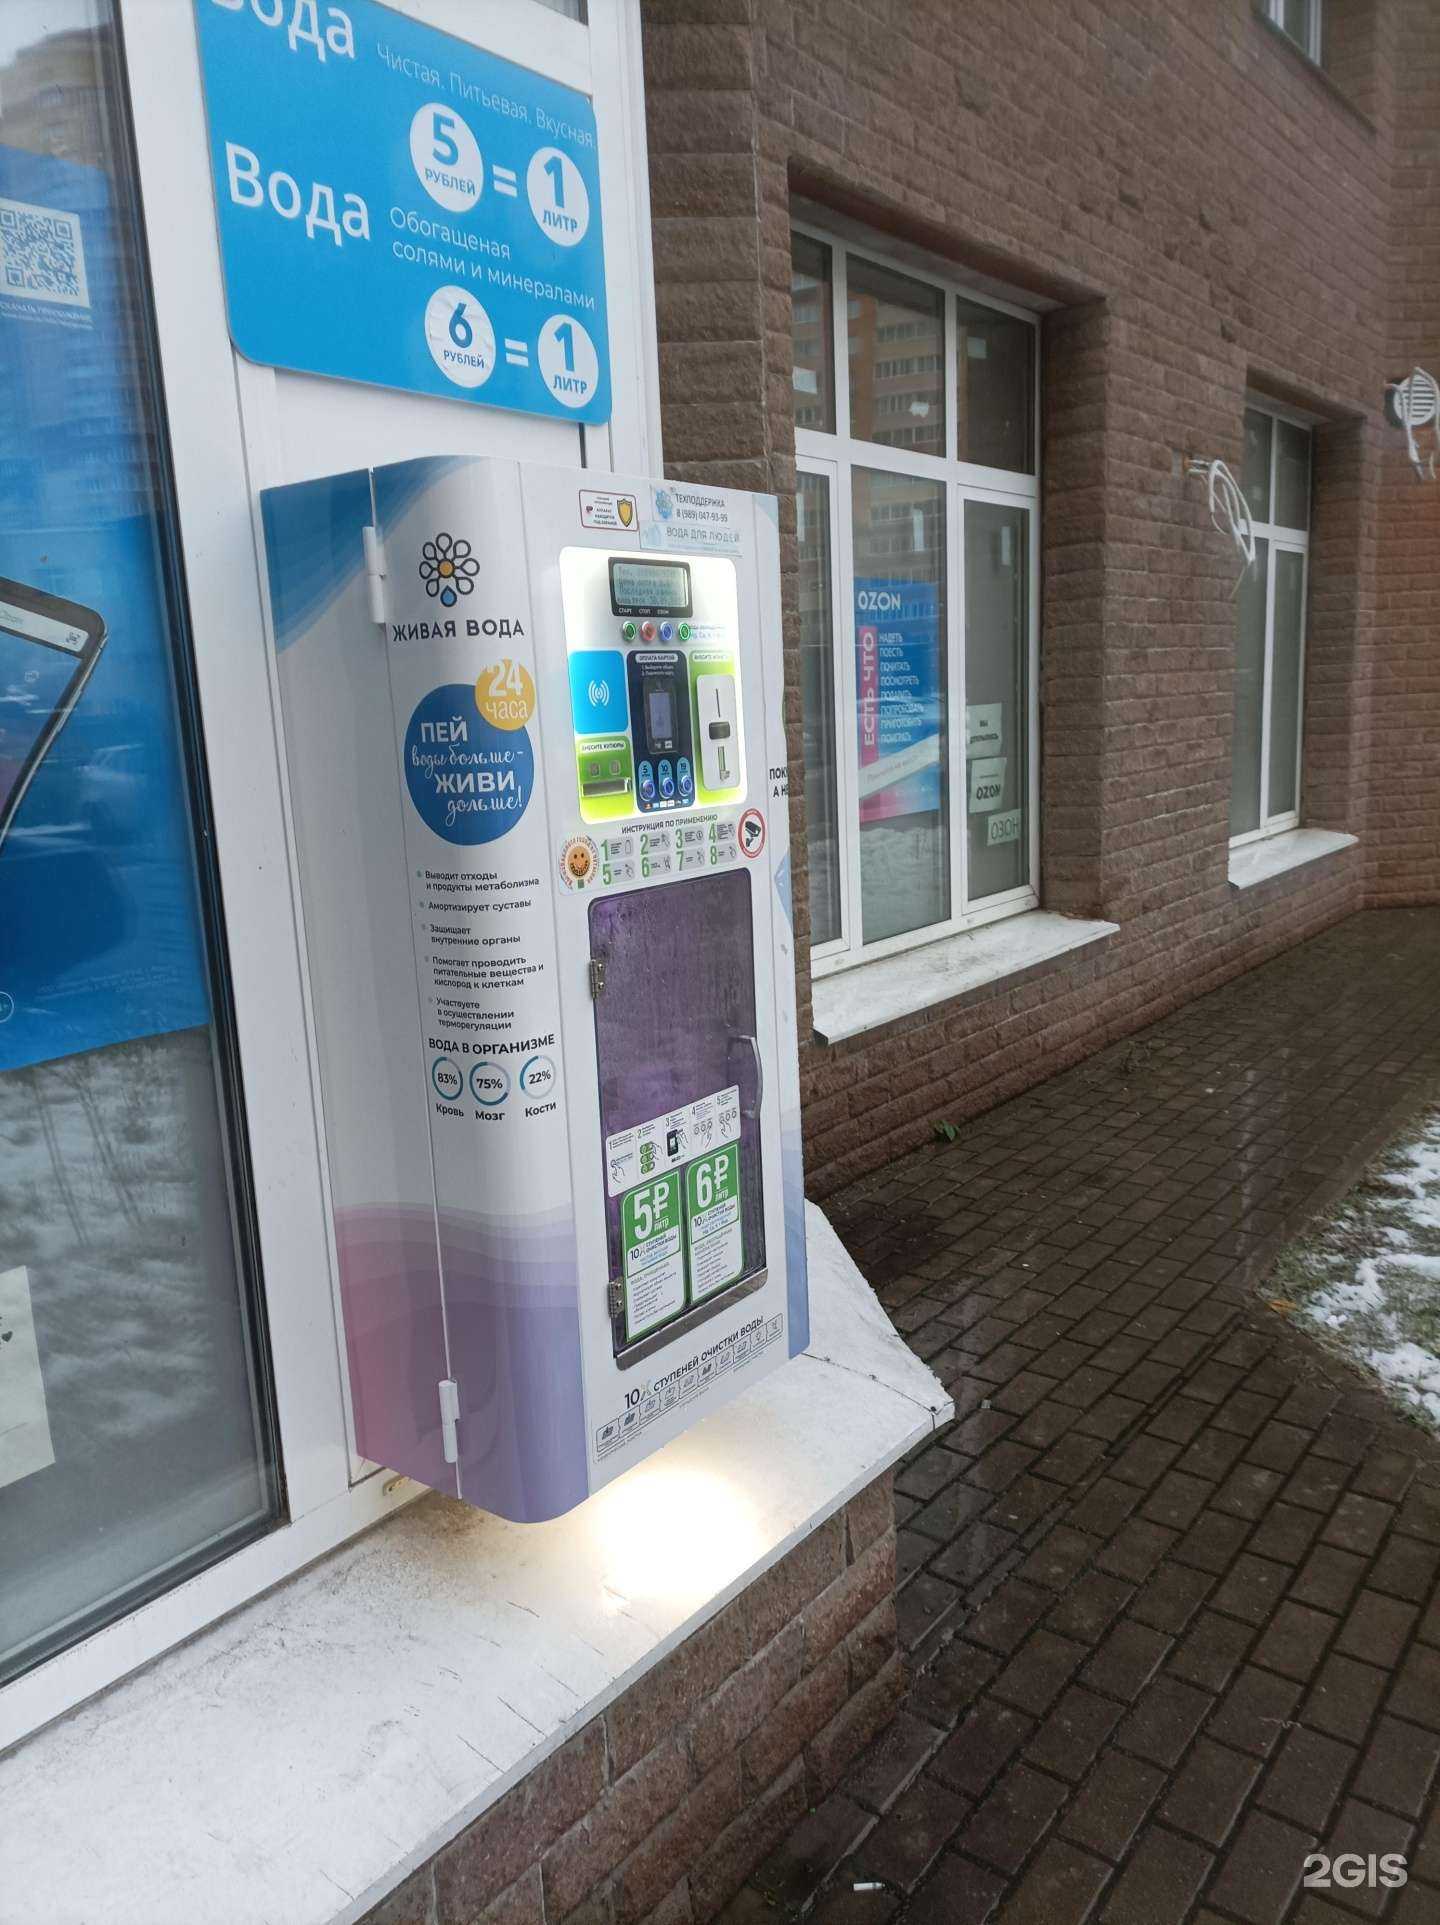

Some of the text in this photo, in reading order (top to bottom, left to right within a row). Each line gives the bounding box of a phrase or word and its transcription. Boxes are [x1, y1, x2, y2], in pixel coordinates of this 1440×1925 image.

[211, 0, 355, 63] ода
[536, 107, 593, 146] Вкусная
[432, 112, 459, 167] 5
[543, 156, 565, 208] 1
[425, 168, 476, 196] РУБЛЕЙ
[225, 141, 371, 247] Вода
[542, 210, 579, 233] ЛИТР
[390, 206, 511, 261] Обогащеная
[392, 239, 595, 311] солями и минералами
[448, 303, 474, 349] 6
[553, 322, 575, 372] 1
[443, 349, 485, 369] РУБЛЕЙ
[553, 375, 588, 395] ЛИТР
[666, 527, 688, 538] ВОДА
[691, 529, 707, 539] ДЛЯ
[858, 590, 901, 611] OZON
[393, 618, 525, 642] ЖИВАЯ ВОДА
[489, 659, 523, 697] 24
[864, 632, 874, 746] ЕСТЬ ЧТО
[486, 699, 528, 720] часа
[420, 716, 468, 743] ПЕЙ
[412, 745, 447, 779] воды
[434, 770, 515, 793] ЖИВИ
[976, 783, 1001, 800] OZON
[445, 785, 523, 827] дольше!
[621, 813, 718, 834] ИНСТРУКЦИЯ ПО ПРИМЕНЕНИЮ
[601, 839, 609, 862] 1
[640, 834, 649, 855] 2
[675, 829, 683, 849] 3
[708, 823, 717, 844] 4
[425, 870, 497, 881] Выводит отходы
[602, 845, 718, 885] 5 6 7 8
[432, 882, 472, 892] продукты
[475, 878, 539, 892] метаболизма
[428, 900, 531, 913] Амортизирует суставы
[430, 924, 471, 935] Защищает
[431, 935, 521, 946] внутренние органы
[432, 956, 527, 969] Помогает проводить
[433, 967, 487, 978] питательные
[489, 965, 537, 978] вещества
[434, 978, 524, 989] кислород к клеткам
[436, 997, 480, 1009] Участвуете
[438, 1018, 512, 1031] терморегуляции
[443, 1009, 514, 1020] осуществлении
[428, 1033, 555, 1055] ВОДА В ОРГАНИЗМЕ
[437, 1070, 551, 1089] 83% 75% 22%
[436, 1101, 557, 1121] Кровь Мозг Кости
[654, 1357, 699, 1392] СТУПЕНЕЙ
[701, 1331, 739, 1361] ОЧИСТКИ
[740, 1315, 764, 1337] ВОДЫ
